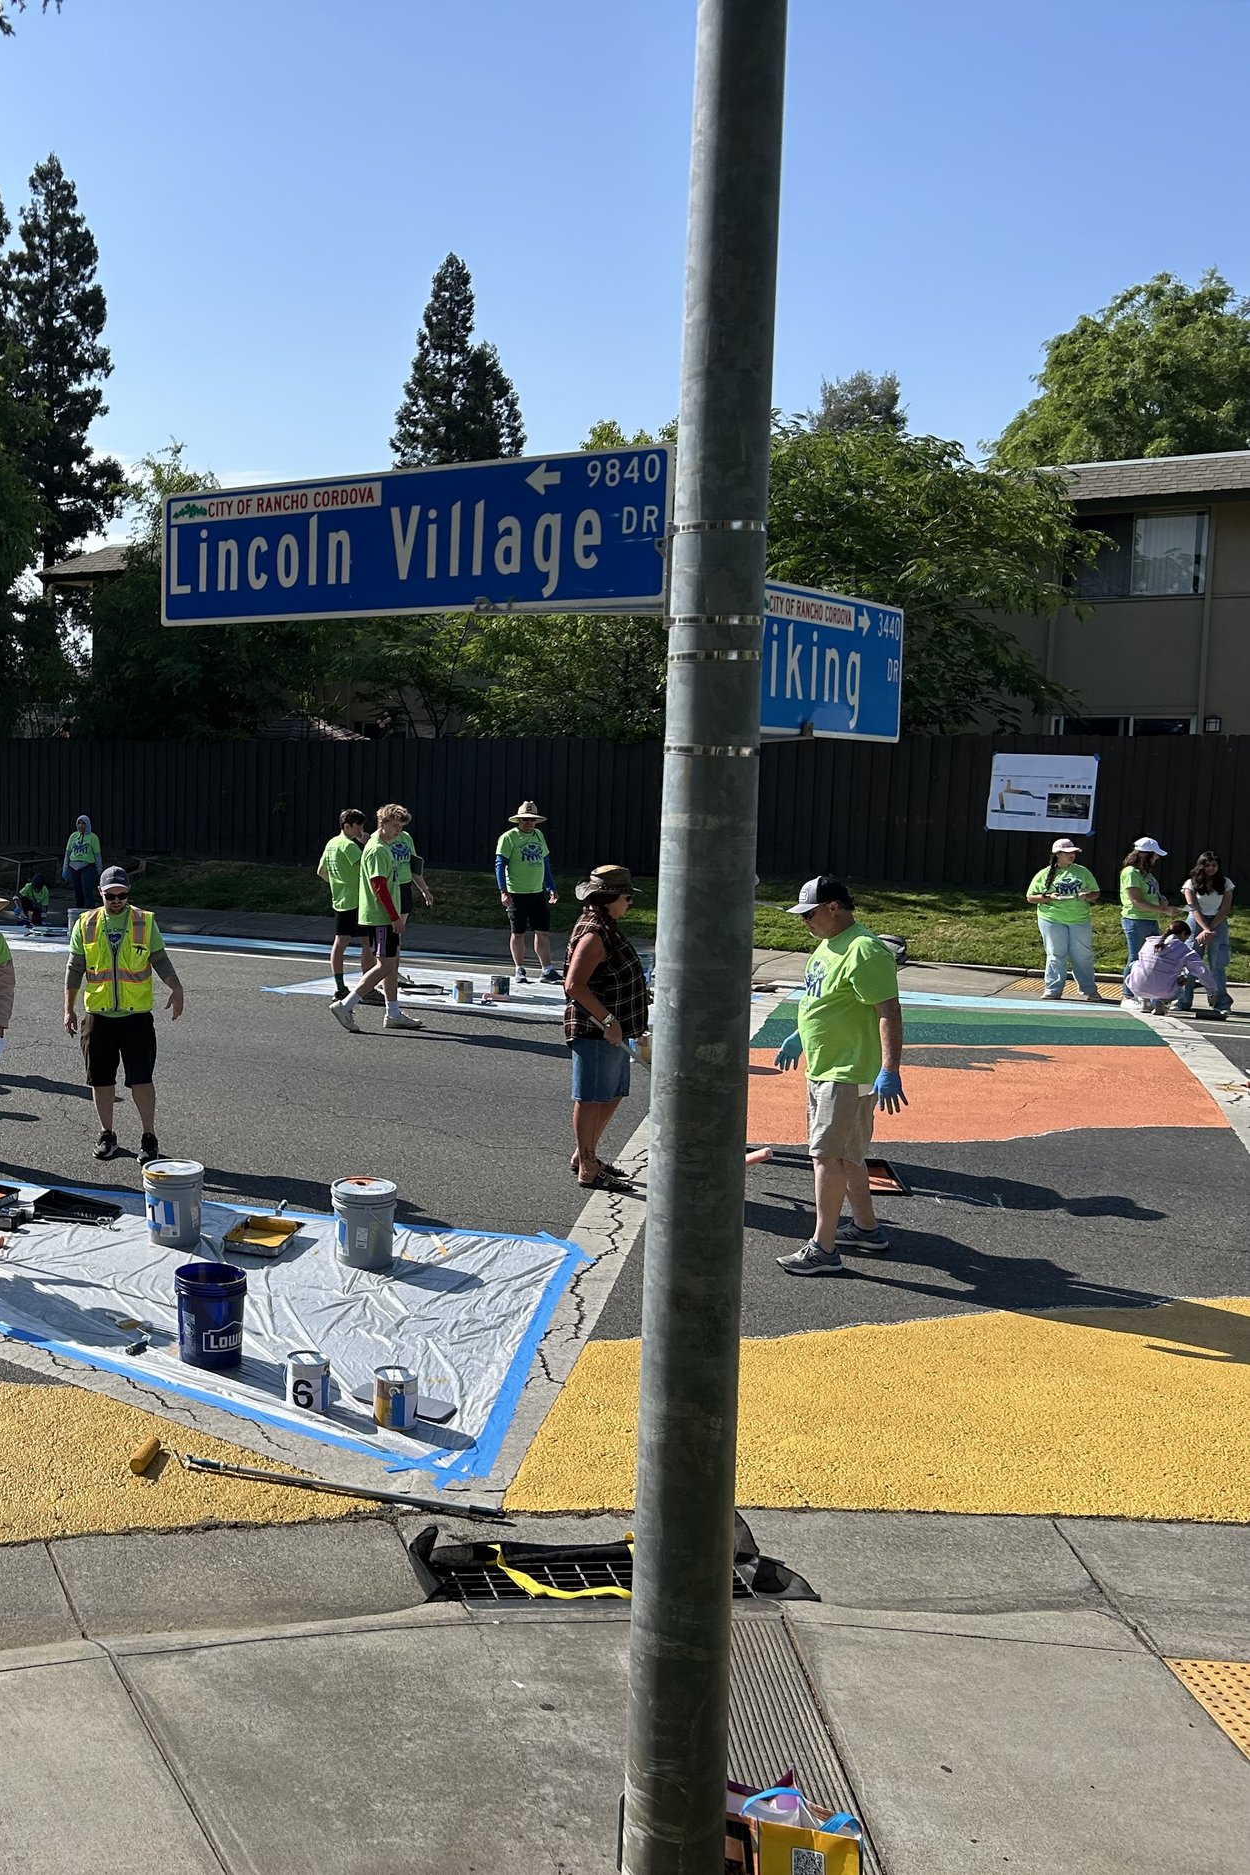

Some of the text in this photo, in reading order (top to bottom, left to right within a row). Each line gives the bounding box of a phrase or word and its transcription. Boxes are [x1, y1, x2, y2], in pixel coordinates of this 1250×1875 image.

[586, 453, 661, 488] 9840
[208, 486, 375, 518] CITY OF RANCHO CORDOVA
[170, 499, 659, 599] Lincoln Village DR
[769, 595, 900, 641] CITY OF RANCHO CORDOVA 3440
[763, 618, 899, 730] iking DR
[292, 1379, 314, 1409] 6
